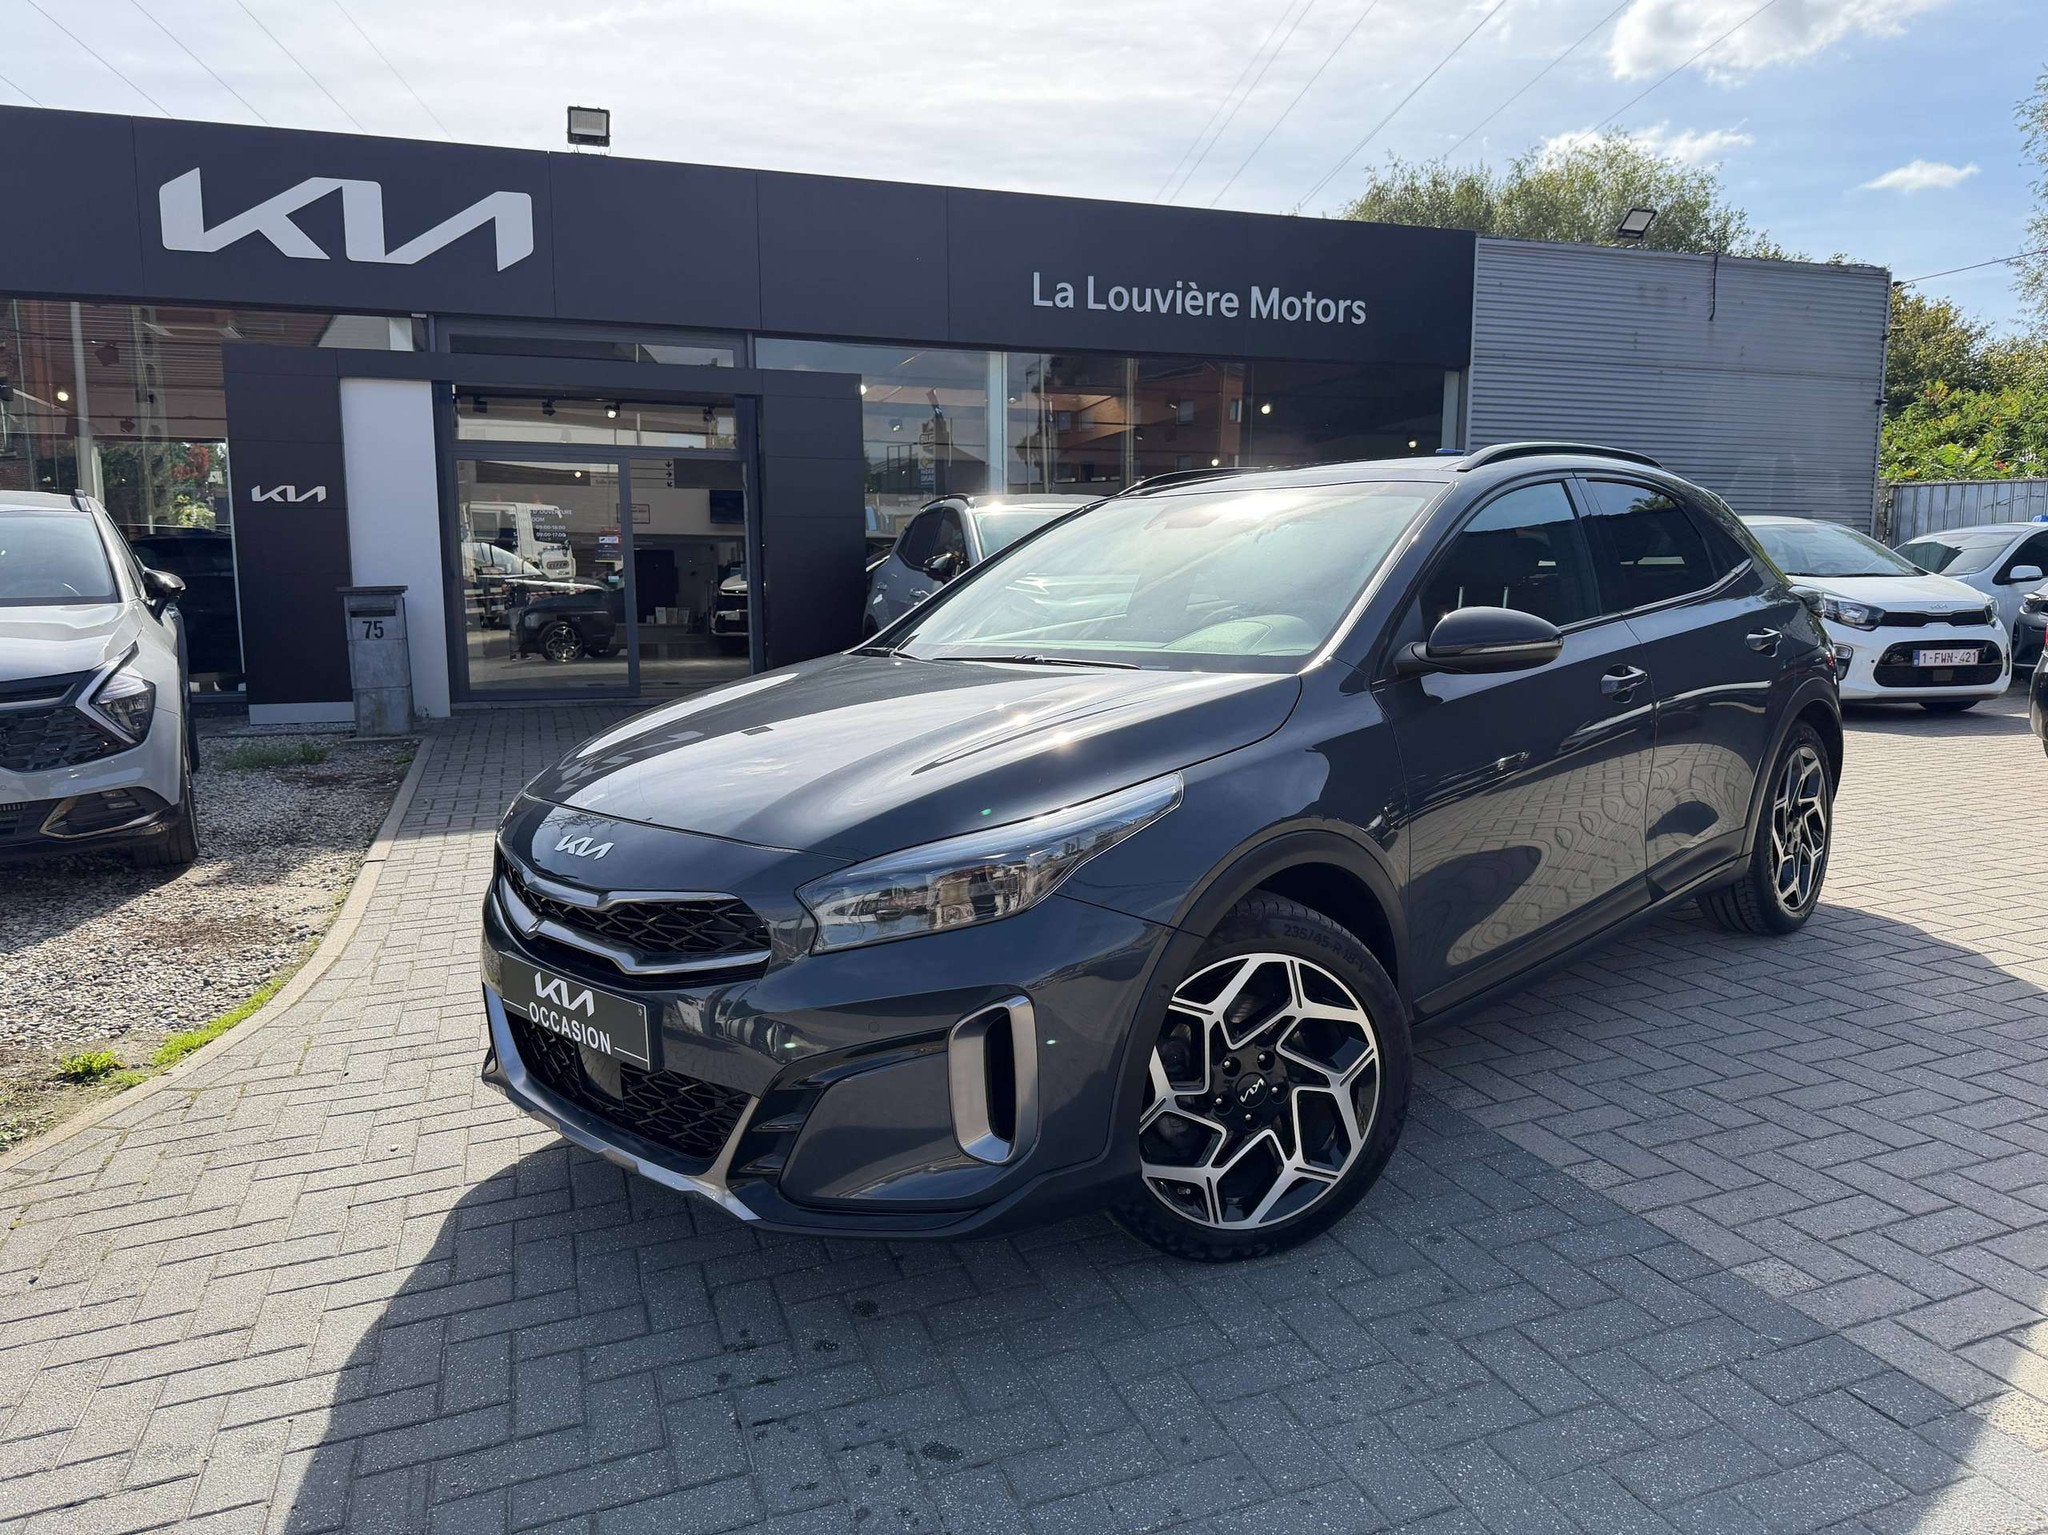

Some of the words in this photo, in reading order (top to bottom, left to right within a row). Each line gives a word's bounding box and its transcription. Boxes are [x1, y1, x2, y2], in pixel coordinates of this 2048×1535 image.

[159, 167, 534, 272] KIA
[1033, 272, 1074, 309] La
[1087, 276, 1239, 318] Louvière
[1250, 285, 1366, 325] Motors
[251, 485, 327, 503] KIA
[362, 620, 384, 640] 75
[1921, 651, 1977, 664] 1-FWN-421
[554, 833, 615, 861] KIA
[534, 971, 595, 1018] KIA
[529, 1001, 612, 1055] OCCASION
